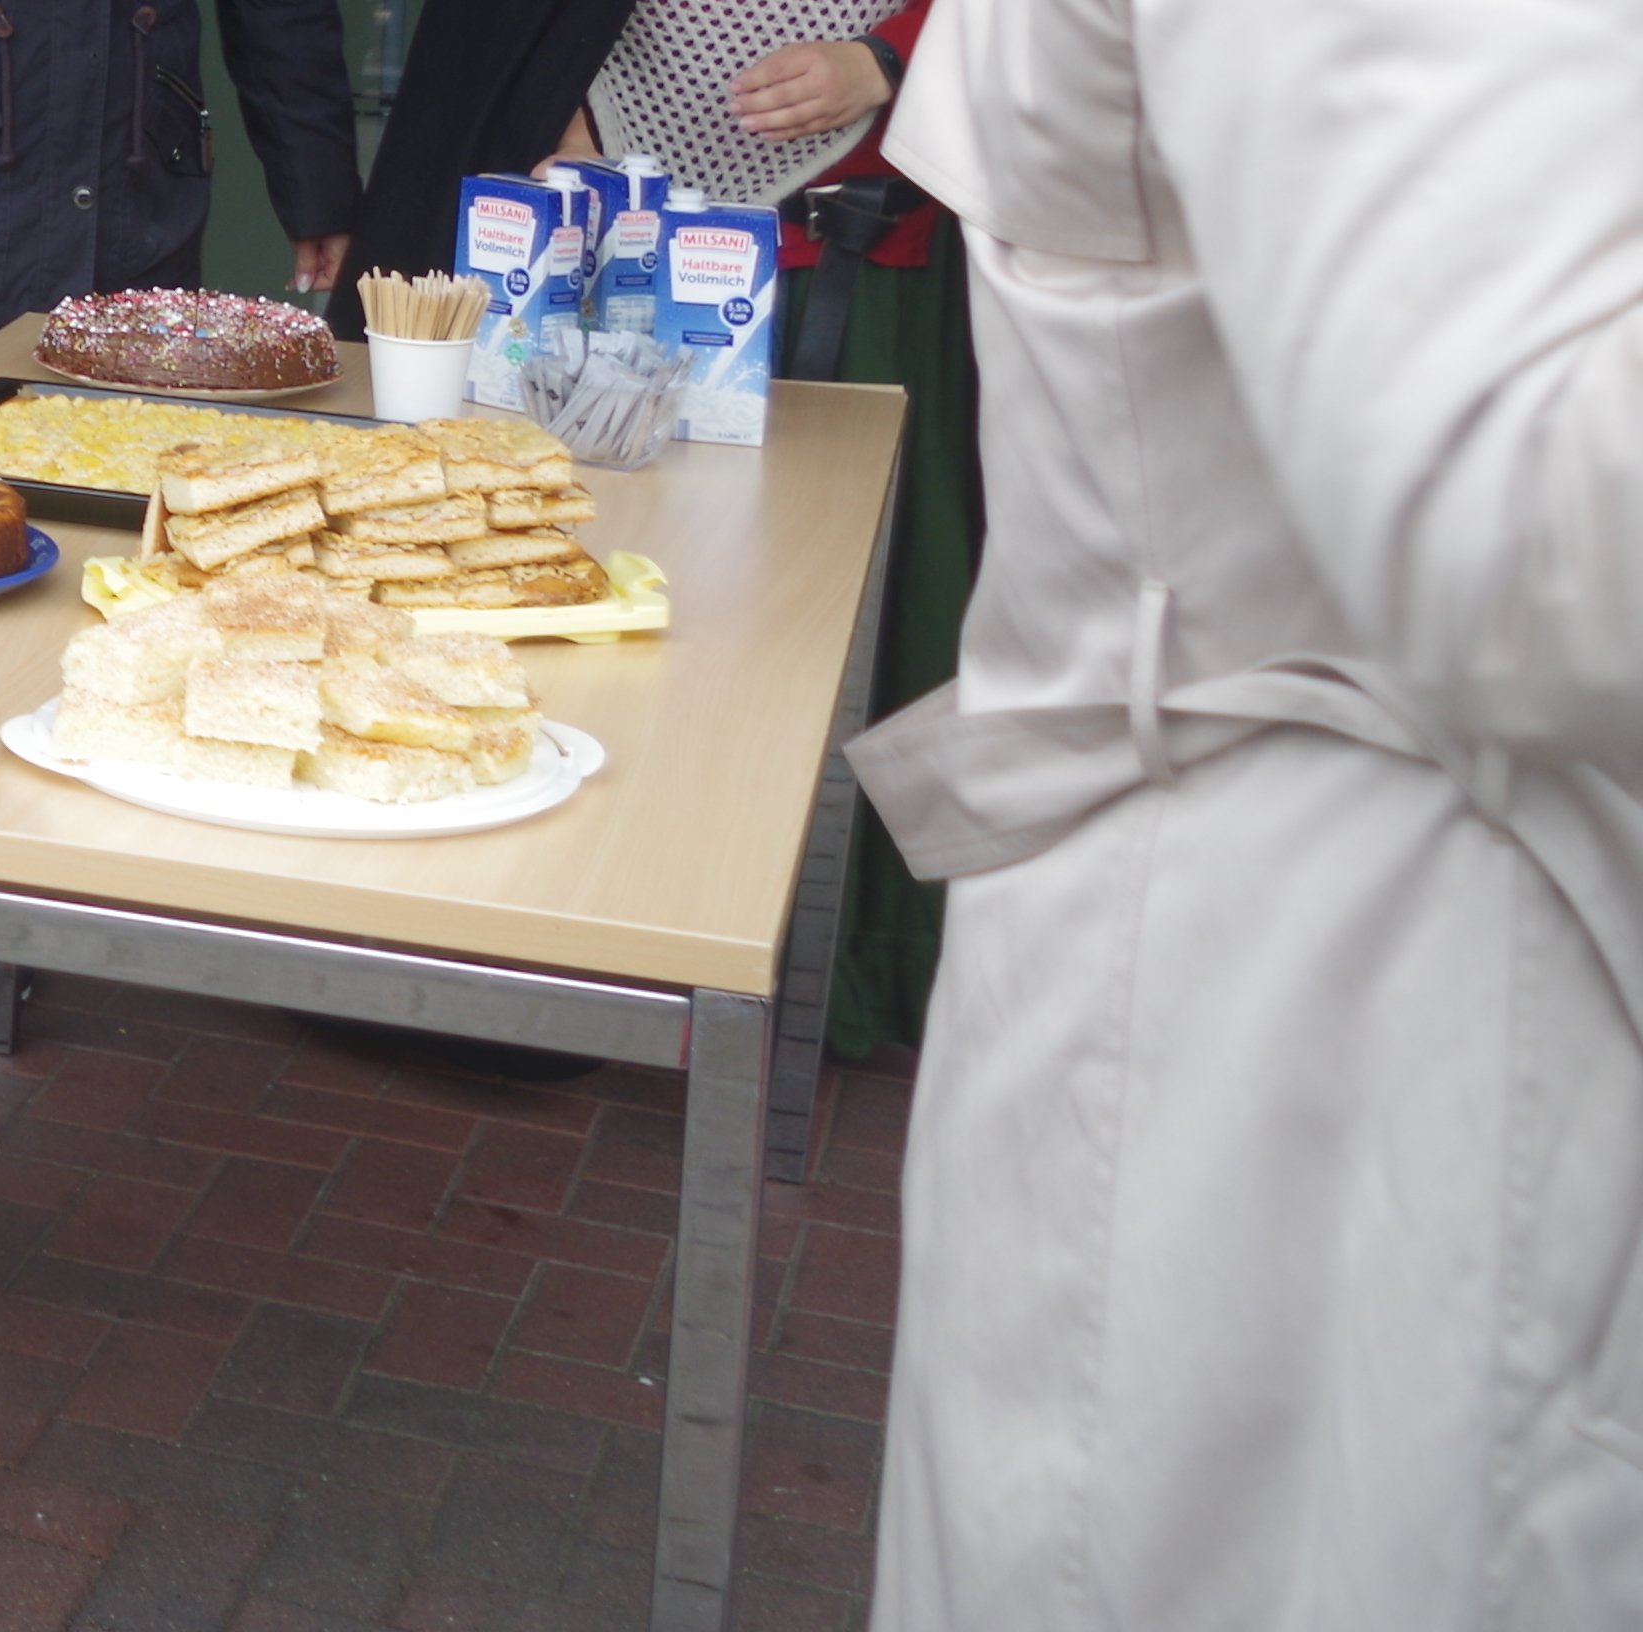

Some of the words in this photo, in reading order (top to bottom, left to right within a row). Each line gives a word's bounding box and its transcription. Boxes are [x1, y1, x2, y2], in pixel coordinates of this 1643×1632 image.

[479, 202, 527, 222] MILSANI
[477, 227, 525, 245] Haltbare
[683, 234, 745, 249] MILSANI
[474, 238, 526, 259] Vollmilch
[681, 258, 744, 274] Haltbare
[678, 272, 746, 287] Vollmilch
[726, 301, 751, 314] 3,5%
[728, 311, 748, 322] Fett
